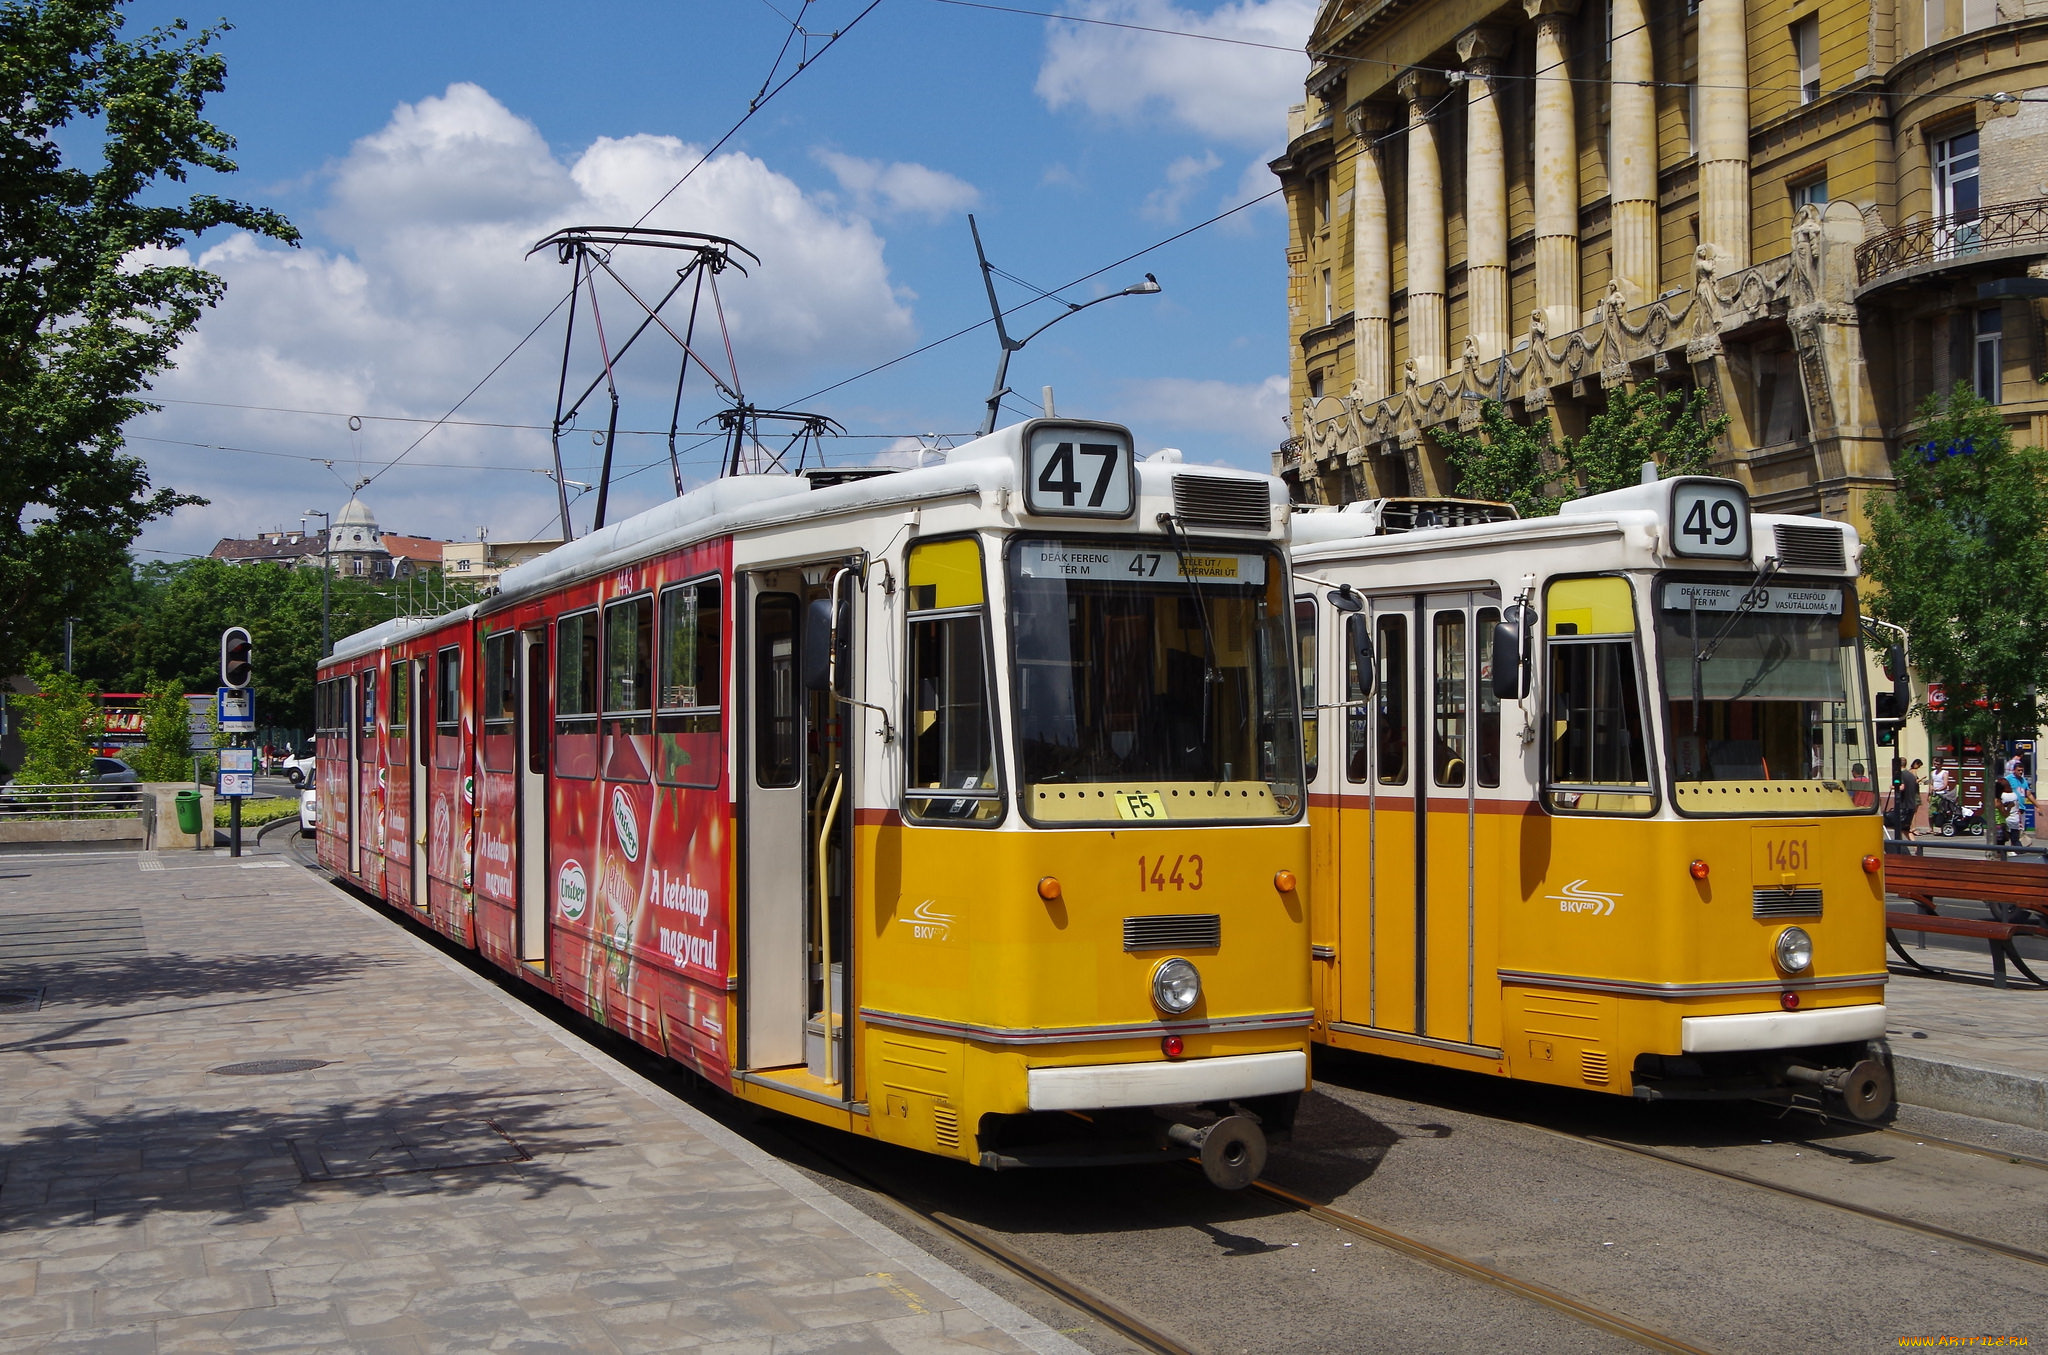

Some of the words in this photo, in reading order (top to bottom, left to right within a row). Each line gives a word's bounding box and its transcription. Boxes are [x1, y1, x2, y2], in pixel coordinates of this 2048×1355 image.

[1039, 443, 1118, 507] 47
[1683, 500, 1738, 545] 49
[1041, 552, 1068, 562] DEÁK
[1071, 554, 1109, 563] FERENC
[1059, 563, 1077, 574] TÉR
[1080, 566, 1090, 574] M
[1128, 554, 1161, 577] 47
[1225, 567, 1236, 576] ÚT
[1703, 589, 1731, 597] FERENC
[1742, 589, 1770, 609] 49
[1788, 591, 1826, 600] KELENFÖLD
[1775, 600, 1828, 610] VASÚTÁLLOMÁS
[1127, 795, 1155, 818] F5
[1767, 840, 1808, 870] 1461
[1138, 854, 1203, 892] 1443
[561, 877, 585, 902] Univer
[650, 868, 660, 904] A
[663, 870, 709, 926] ketchup
[914, 925, 934, 939] BKV
[660, 926, 718, 970] magyarul
